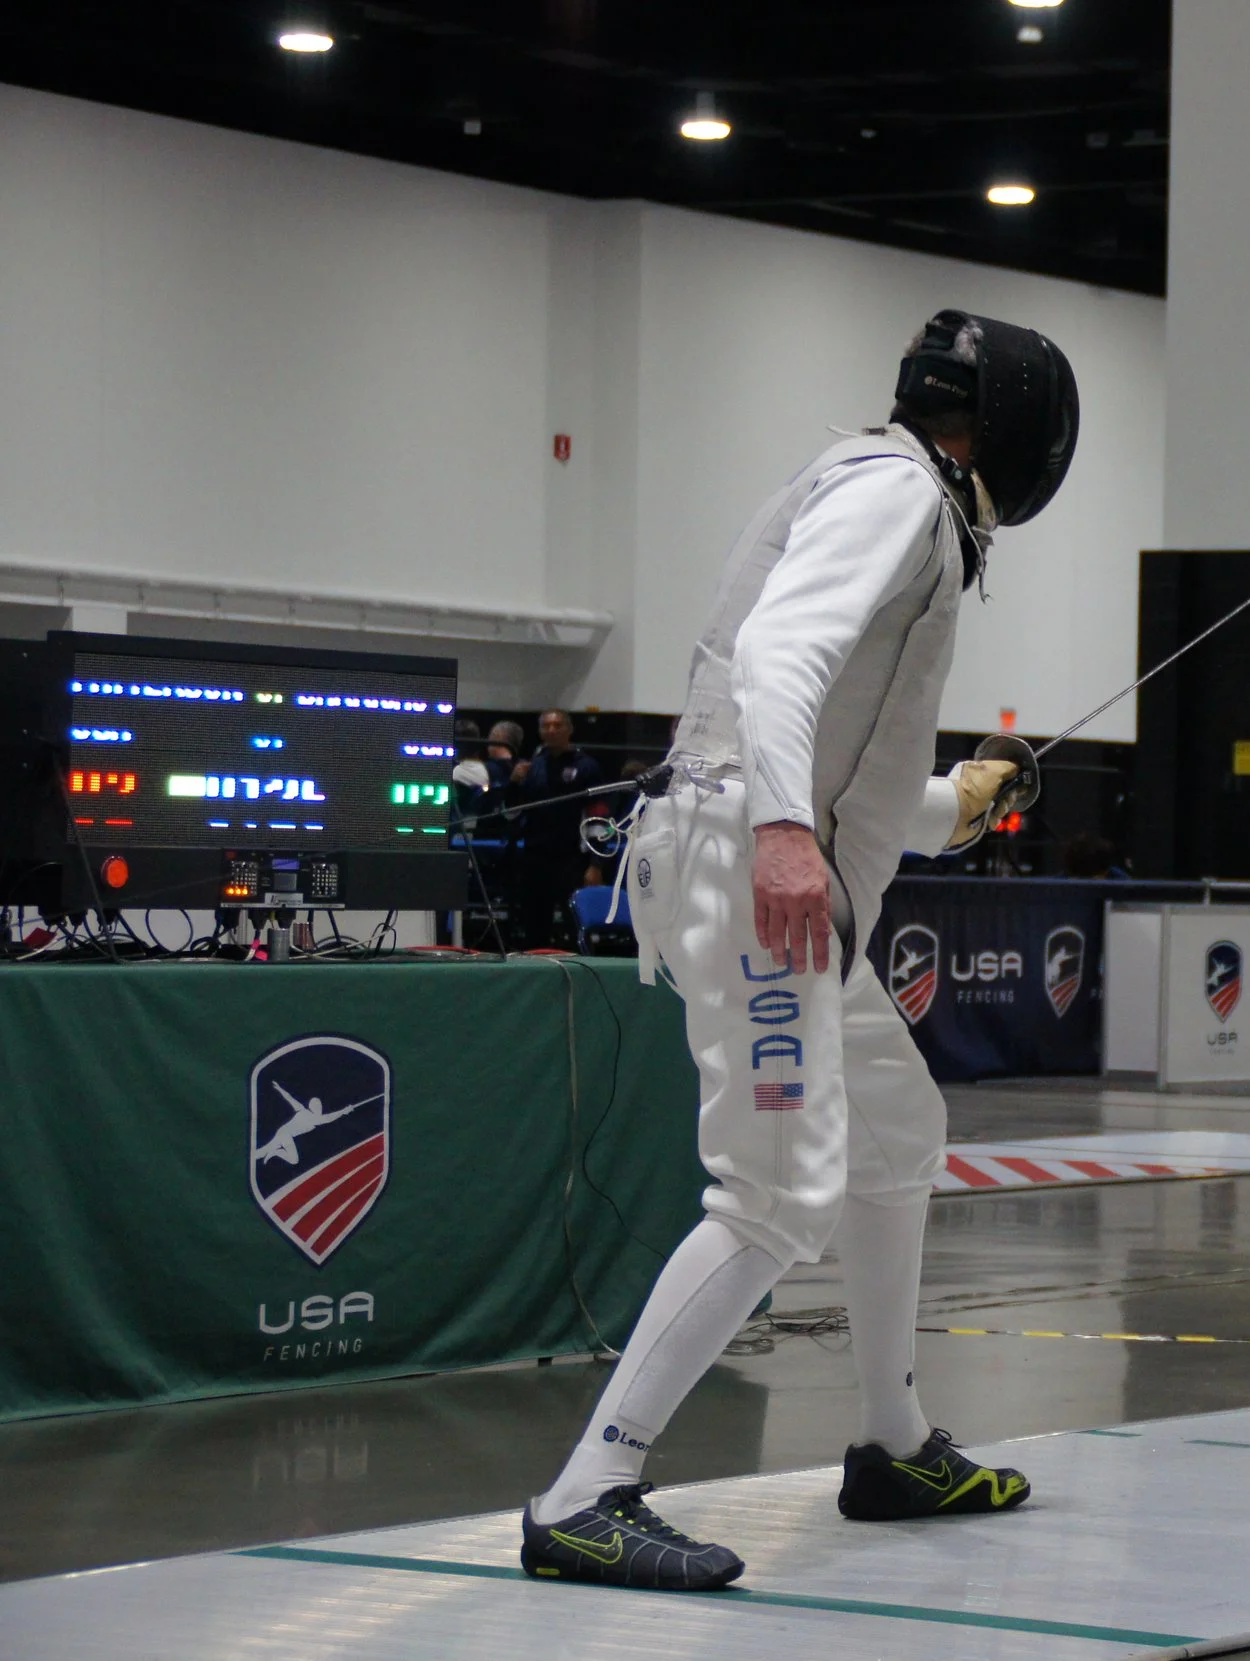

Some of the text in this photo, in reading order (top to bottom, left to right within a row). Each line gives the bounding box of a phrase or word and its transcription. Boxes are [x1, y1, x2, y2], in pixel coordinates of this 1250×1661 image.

[951, 951, 1022, 981] USA
[740, 948, 803, 1070] USA
[956, 989, 1015, 1004] FENCING
[1206, 1031, 1238, 1046] USA
[259, 1291, 375, 1335] USA
[263, 1337, 363, 1362] FENCING
